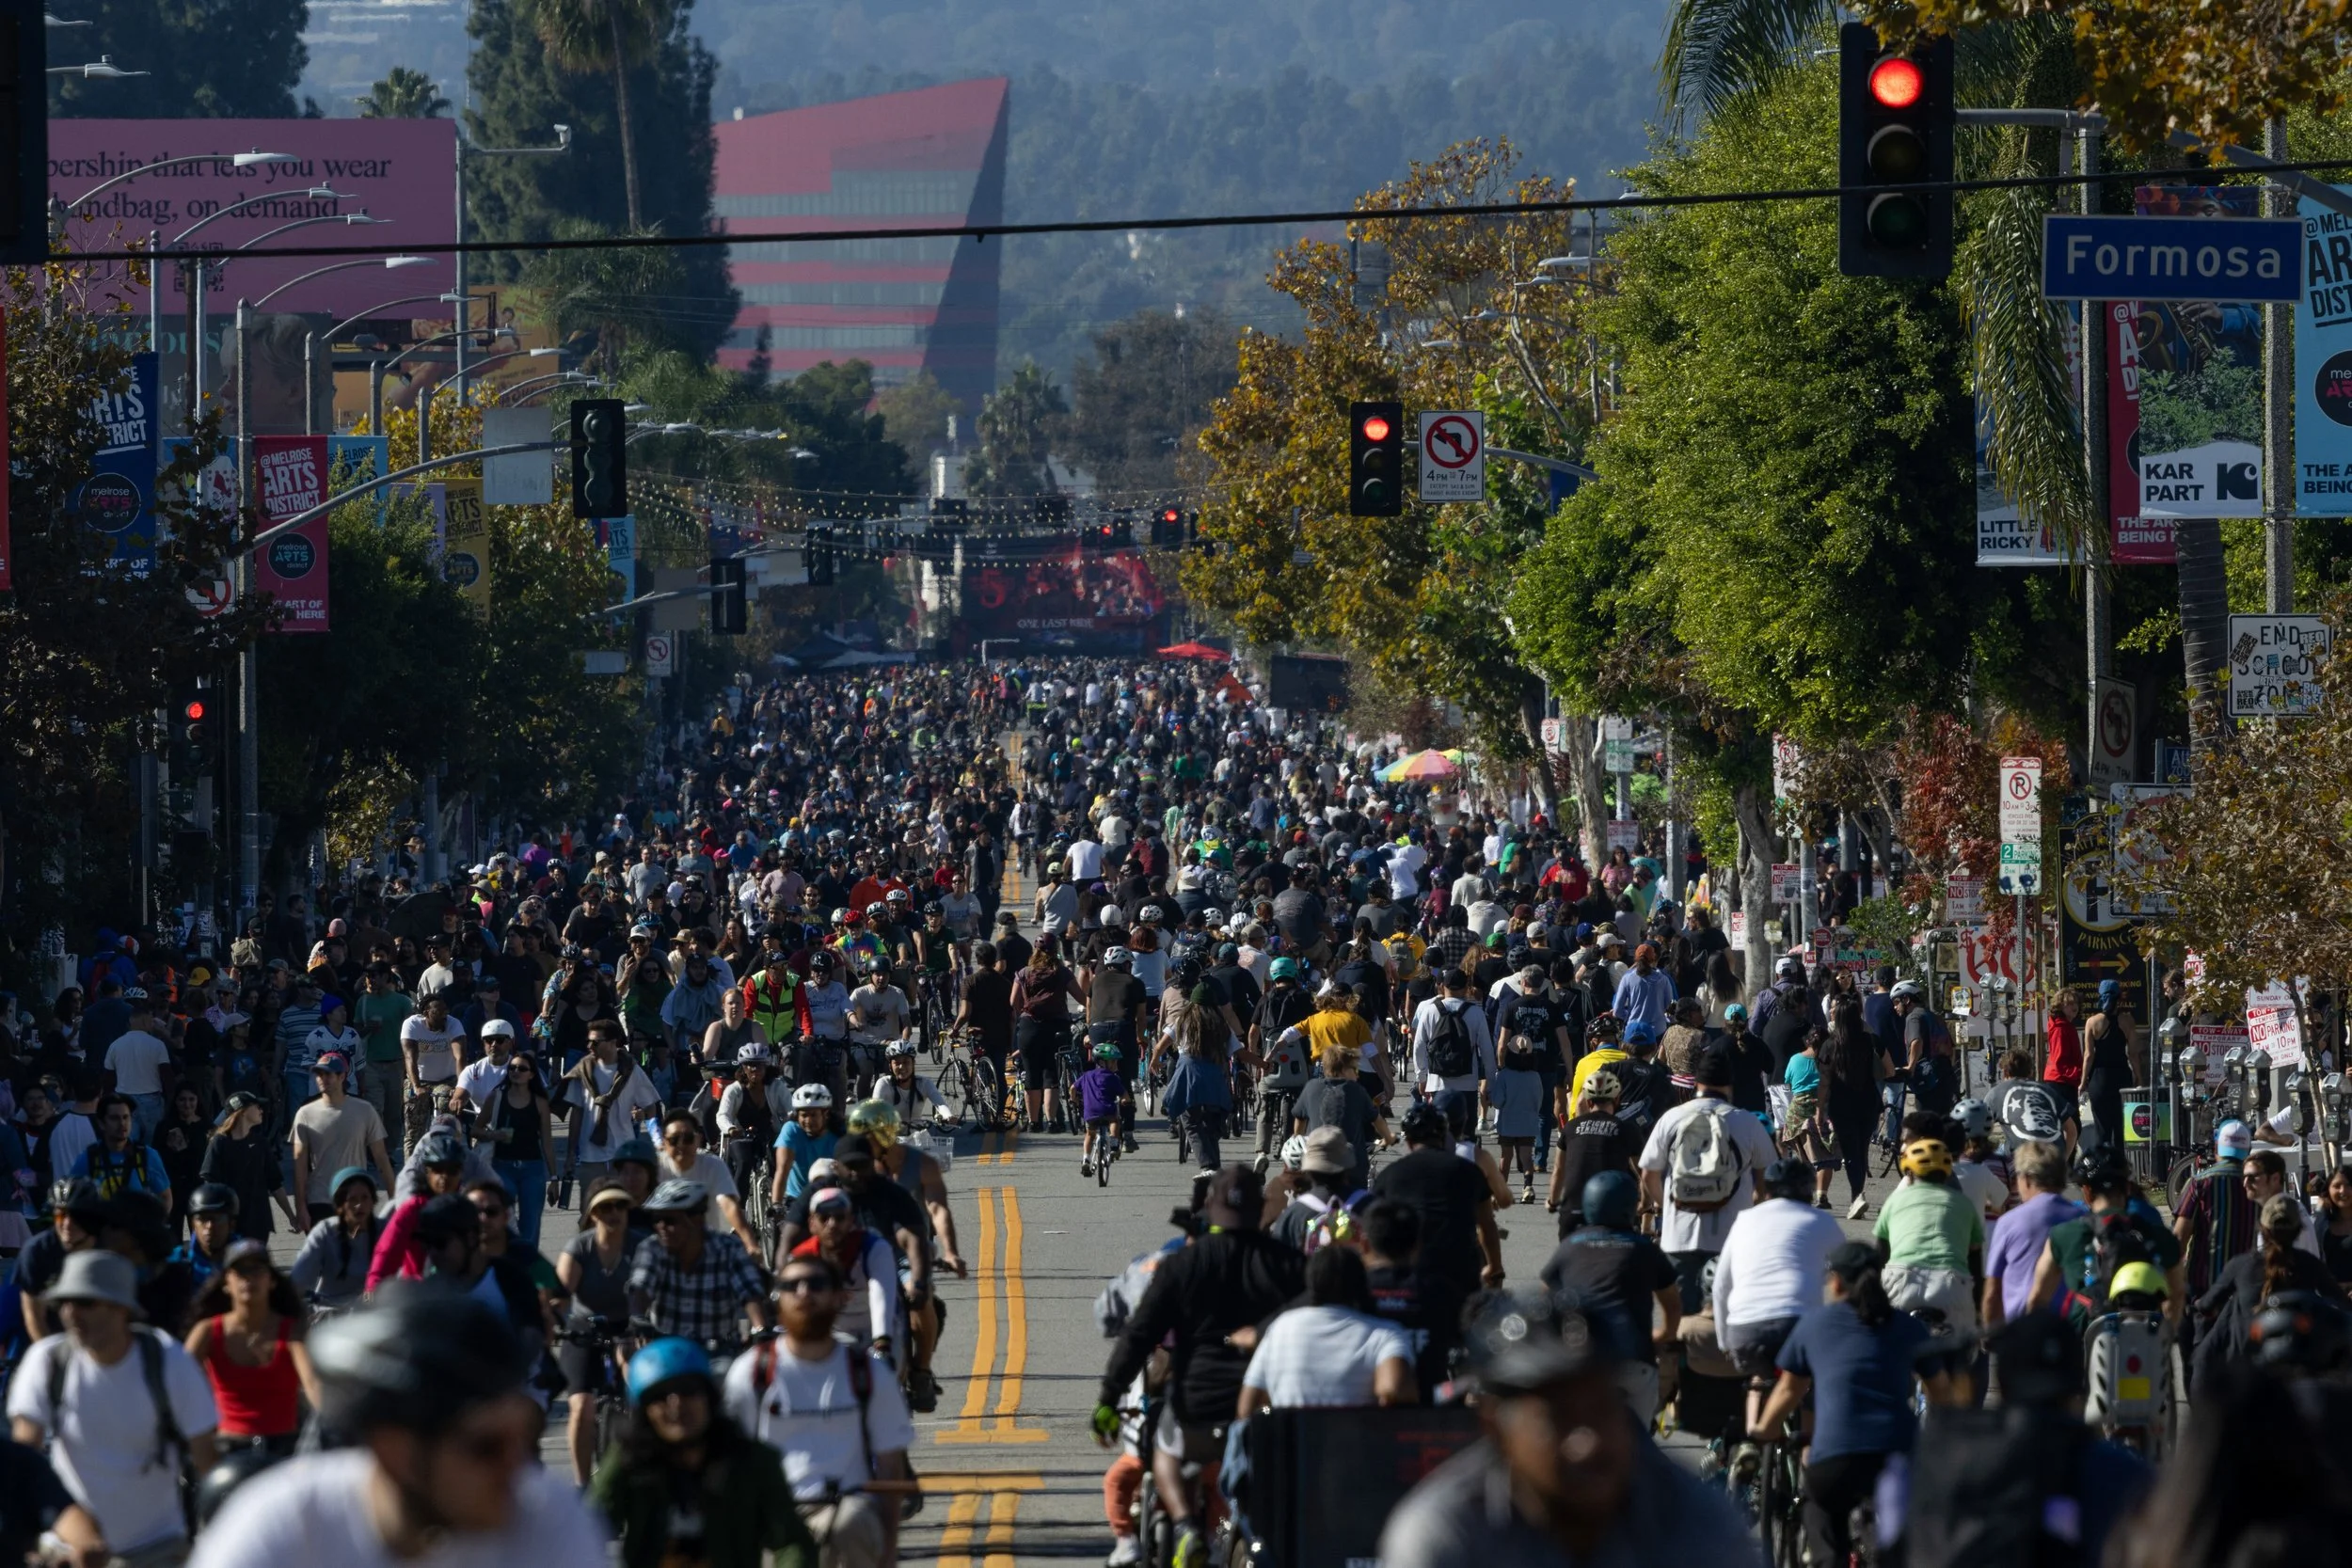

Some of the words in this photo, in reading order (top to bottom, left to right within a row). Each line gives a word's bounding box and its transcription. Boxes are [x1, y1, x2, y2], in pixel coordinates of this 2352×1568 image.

[152, 154, 201, 178] that
[212, 151, 258, 178] lets
[263, 159, 314, 183] you
[321, 158, 391, 178] wear
[54, 192, 180, 225] hndbag,
[187, 201, 220, 219] on
[2067, 234, 2281, 279] Formosa
[261, 447, 313, 467] @MELROSE
[2146, 464, 2193, 480] KAR
[2303, 465, 2340, 477] THE
[264, 461, 319, 498] ARTS
[91, 487, 130, 497] melrose
[2146, 485, 2204, 501] PART
[265, 489, 321, 515] DISTRICT
[1979, 519, 2039, 533] LITTLE
[2117, 516, 2149, 529] THE
[1979, 536, 2034, 549] RICKY
[2118, 531, 2167, 544] BEING
[275, 551, 310, 562] ARTS
[980, 569, 1006, 609] 5
[285, 599, 306, 609] ART
[309, 599, 323, 609] OF
[296, 610, 326, 619] HERE
[1017, 618, 1039, 629] ONE
[1041, 618, 1068, 628] LAST
[2261, 626, 2300, 645] END
[2004, 845, 2011, 859] 2
[1949, 887, 1963, 897] NO
[1836, 949, 1862, 960] ALL
[2185, 960, 2201, 976] NO
[2255, 1011, 2289, 1023] TEMPORARY
[2252, 1023, 2266, 1041] NO
[2266, 1019, 2296, 1036] PARKING
[2193, 1041, 2211, 1055] NO
[2277, 1036, 2296, 1050] 10PM
